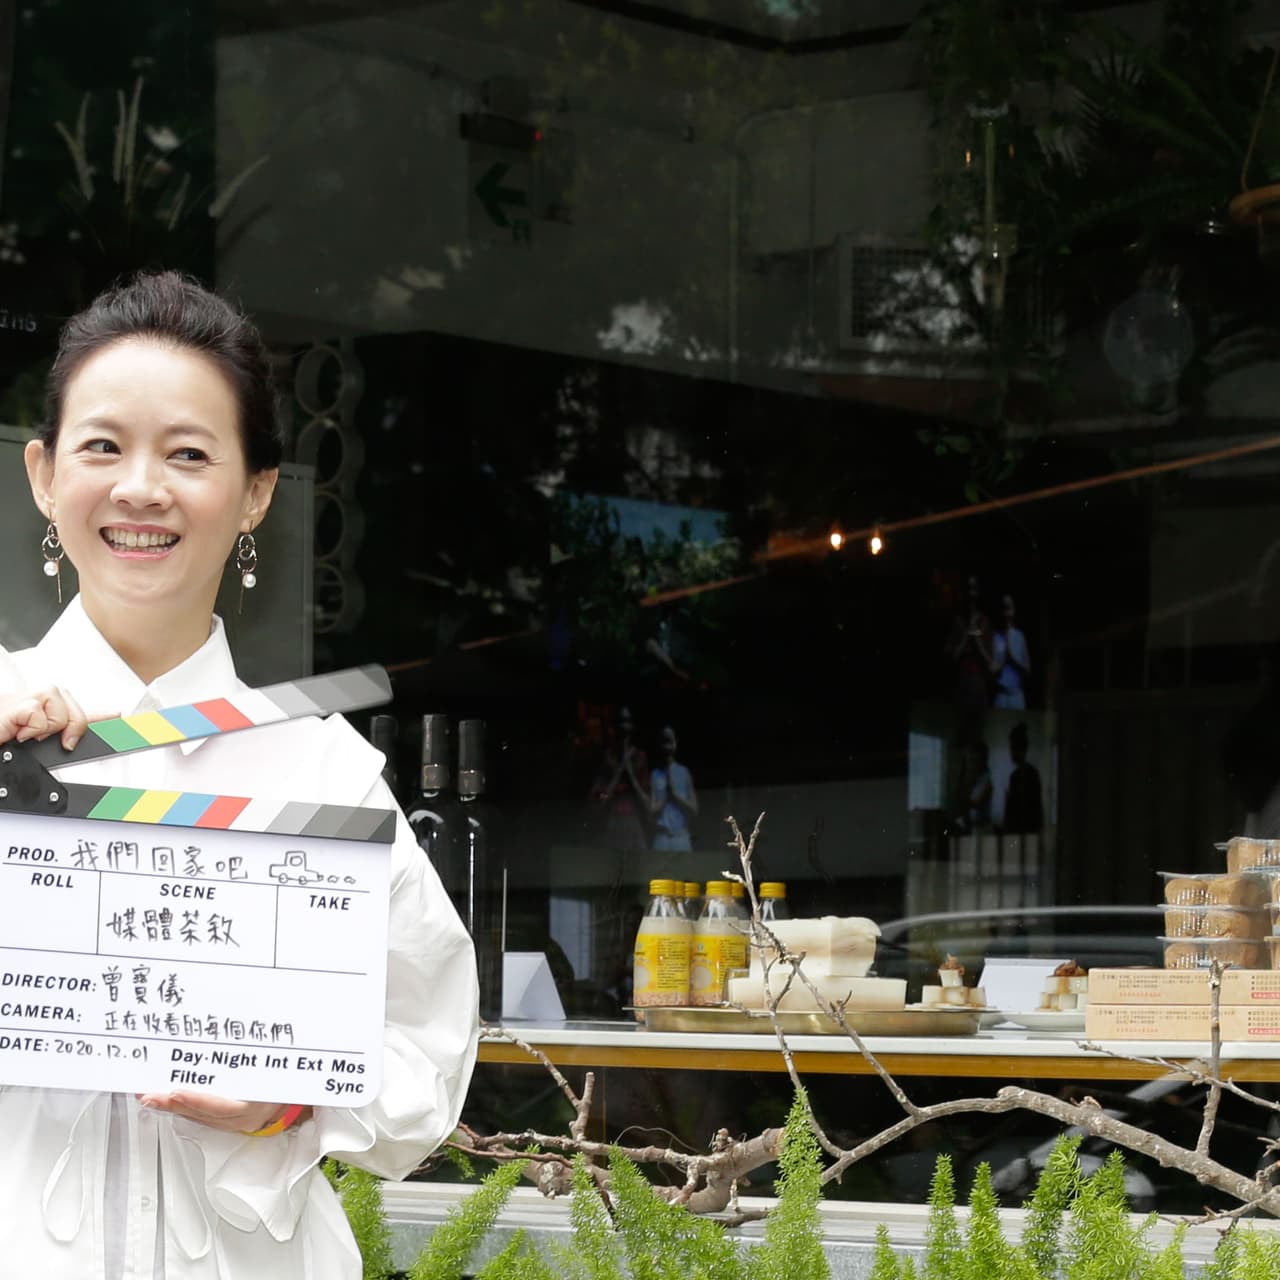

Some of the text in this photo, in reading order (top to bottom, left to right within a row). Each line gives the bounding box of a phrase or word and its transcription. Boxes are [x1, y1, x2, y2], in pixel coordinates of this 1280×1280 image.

[7, 846, 59, 863] PROD.
[70, 839, 249, 880] 我們回家吧
[30, 872, 75, 889] ROLL
[159, 883, 217, 900] SCENE
[309, 895, 352, 911] TAKE
[1, 973, 97, 993] DIRECTOR:
[102, 964, 186, 1008] 曾寶儀
[0, 1003, 82, 1023] CAMERA:
[104, 1010, 295, 1046] 正在收看的每個你們
[0, 1036, 49, 1052] DATE:
[265, 1054, 289, 1069] Int
[297, 1057, 324, 1072] Ext
[331, 1059, 366, 1075] Mos
[170, 1069, 216, 1085] Filter
[325, 1078, 365, 1095] Sync
